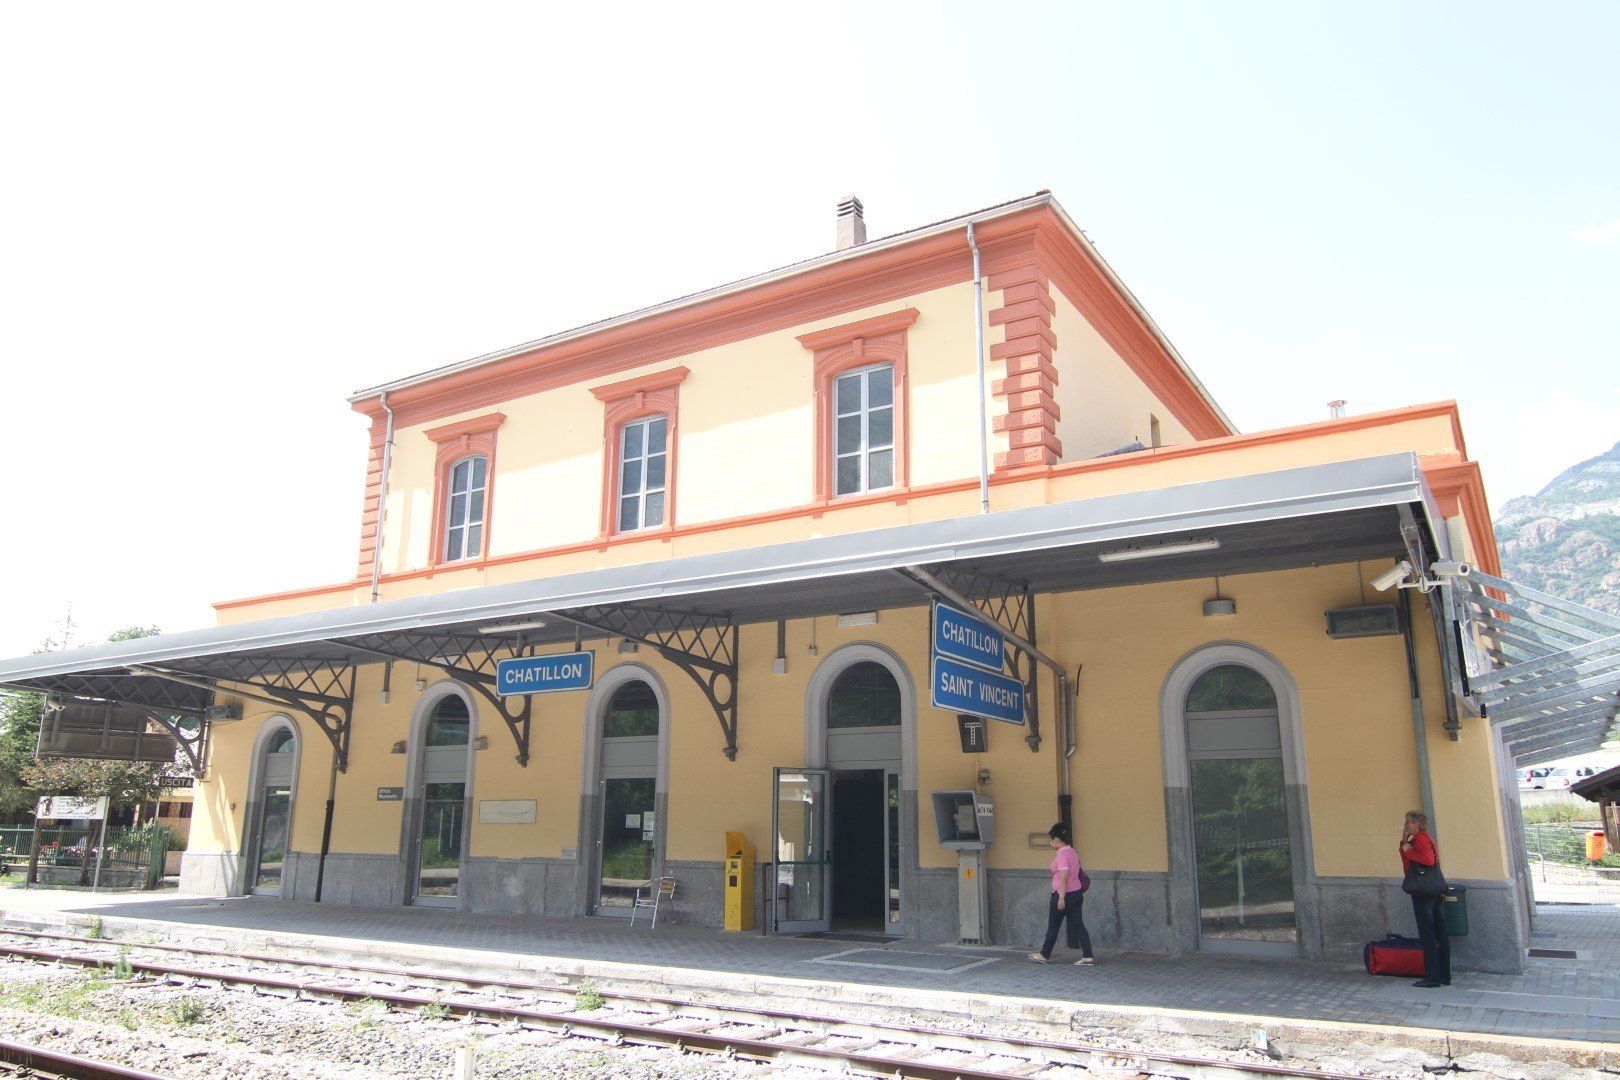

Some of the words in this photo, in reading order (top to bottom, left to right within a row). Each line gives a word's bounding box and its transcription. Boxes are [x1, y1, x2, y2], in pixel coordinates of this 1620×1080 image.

[942, 620, 999, 656] CHATILLON
[505, 663, 583, 684] CHATILLON
[941, 671, 974, 698] SAINT
[979, 682, 1019, 710] VINCENT
[964, 722, 982, 746] T
[161, 777, 192, 787] USCITA
